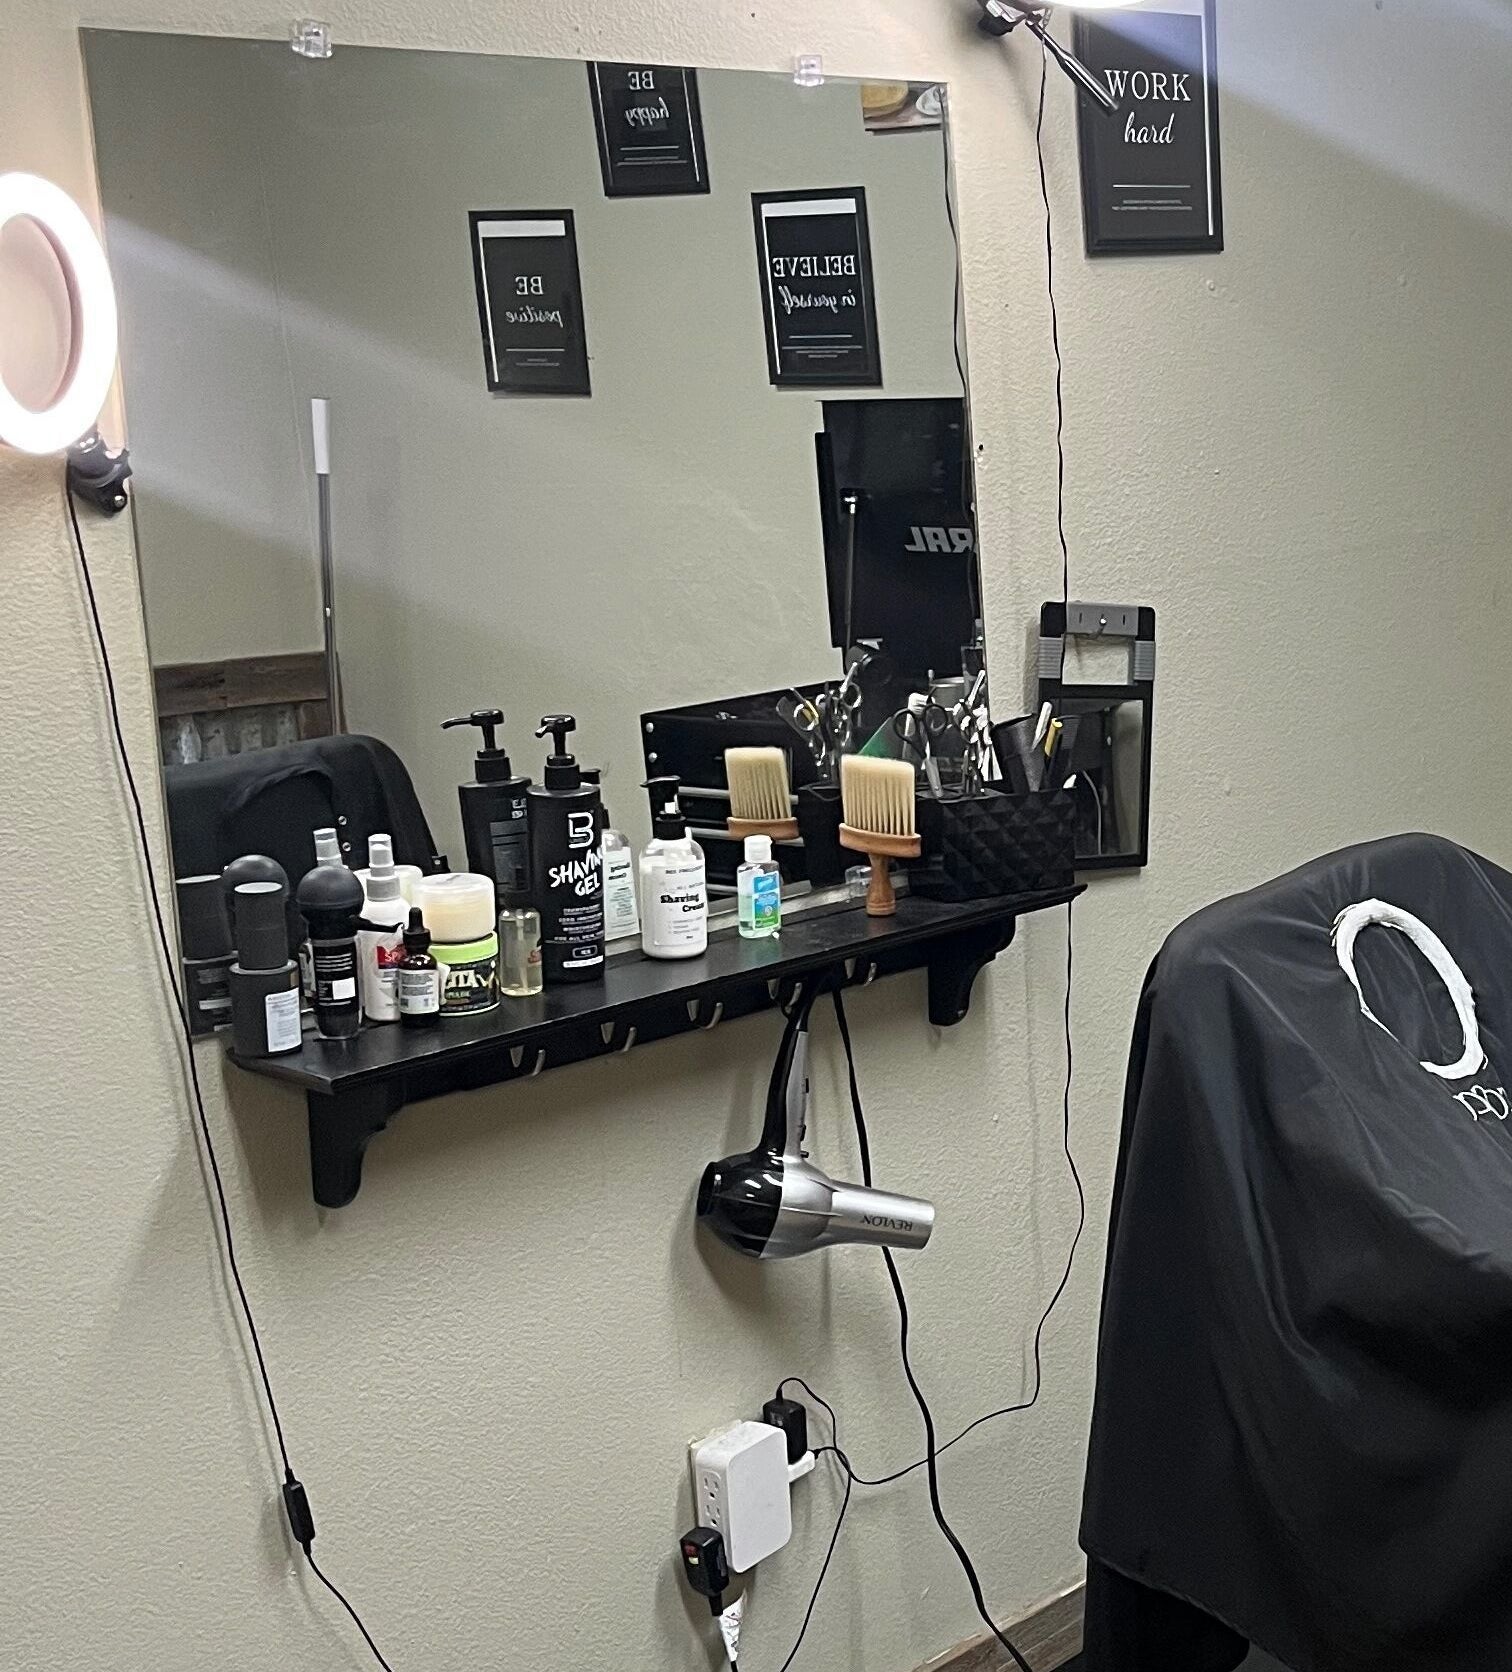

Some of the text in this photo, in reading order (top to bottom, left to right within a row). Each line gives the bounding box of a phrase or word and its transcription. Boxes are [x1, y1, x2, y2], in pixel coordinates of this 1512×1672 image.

[1104, 69, 1192, 101] WORK
[1124, 111, 1175, 144] hard
[574, 872, 601, 896] GEL
[860, 1214, 913, 1231] REVLON
